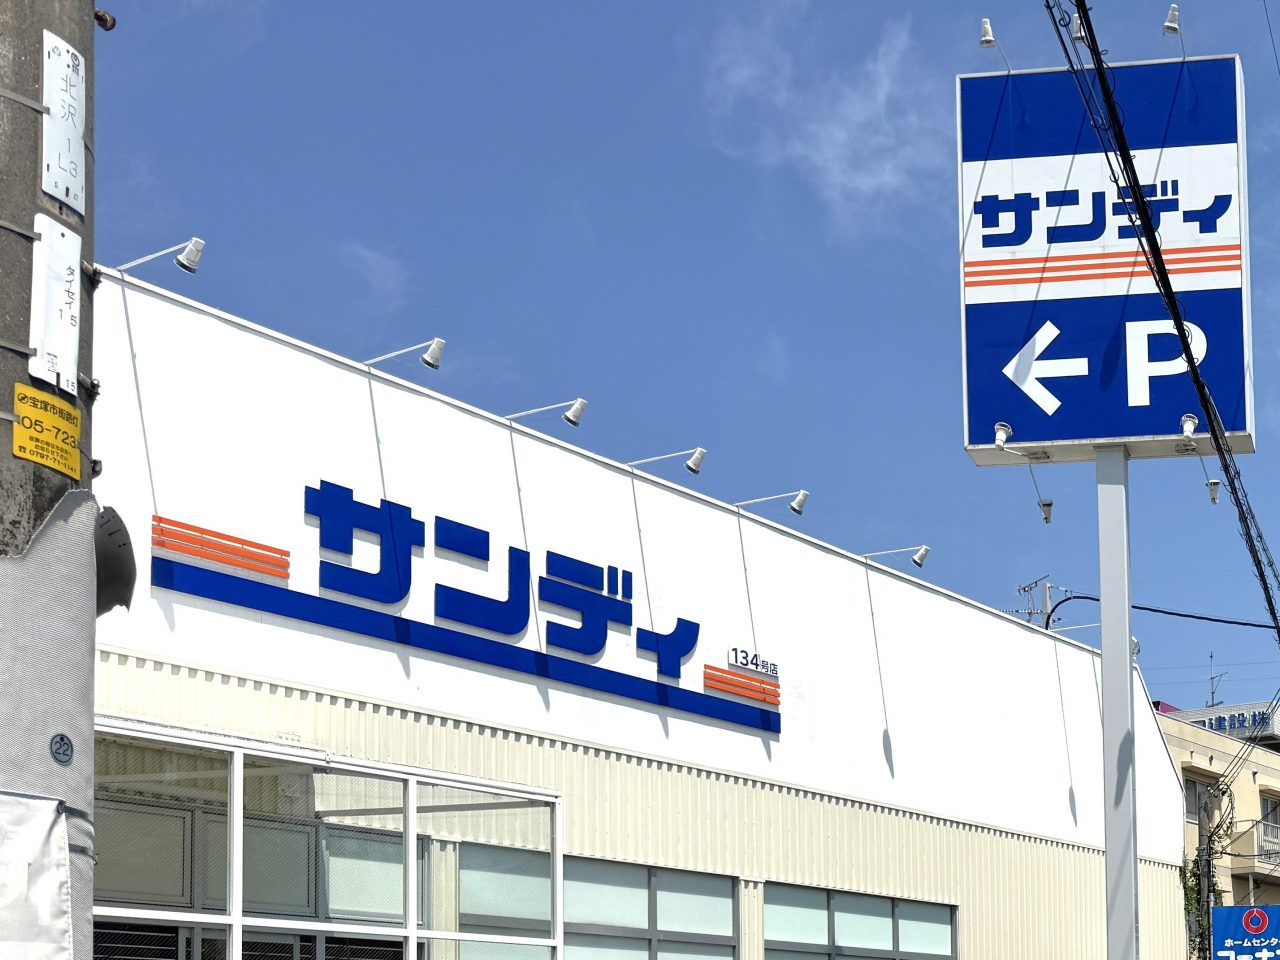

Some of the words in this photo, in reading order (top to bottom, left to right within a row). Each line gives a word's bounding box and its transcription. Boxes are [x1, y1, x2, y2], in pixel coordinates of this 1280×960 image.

[973, 179, 1233, 249] サンディ
[64, 265, 76, 310] タイセイ
[1125, 319, 1208, 407] P
[28, 395, 79, 428] 宝塚市街路灯
[304, 478, 700, 679] サンディ
[731, 647, 778, 676] 134号店
[54, 741, 70, 757] 22
